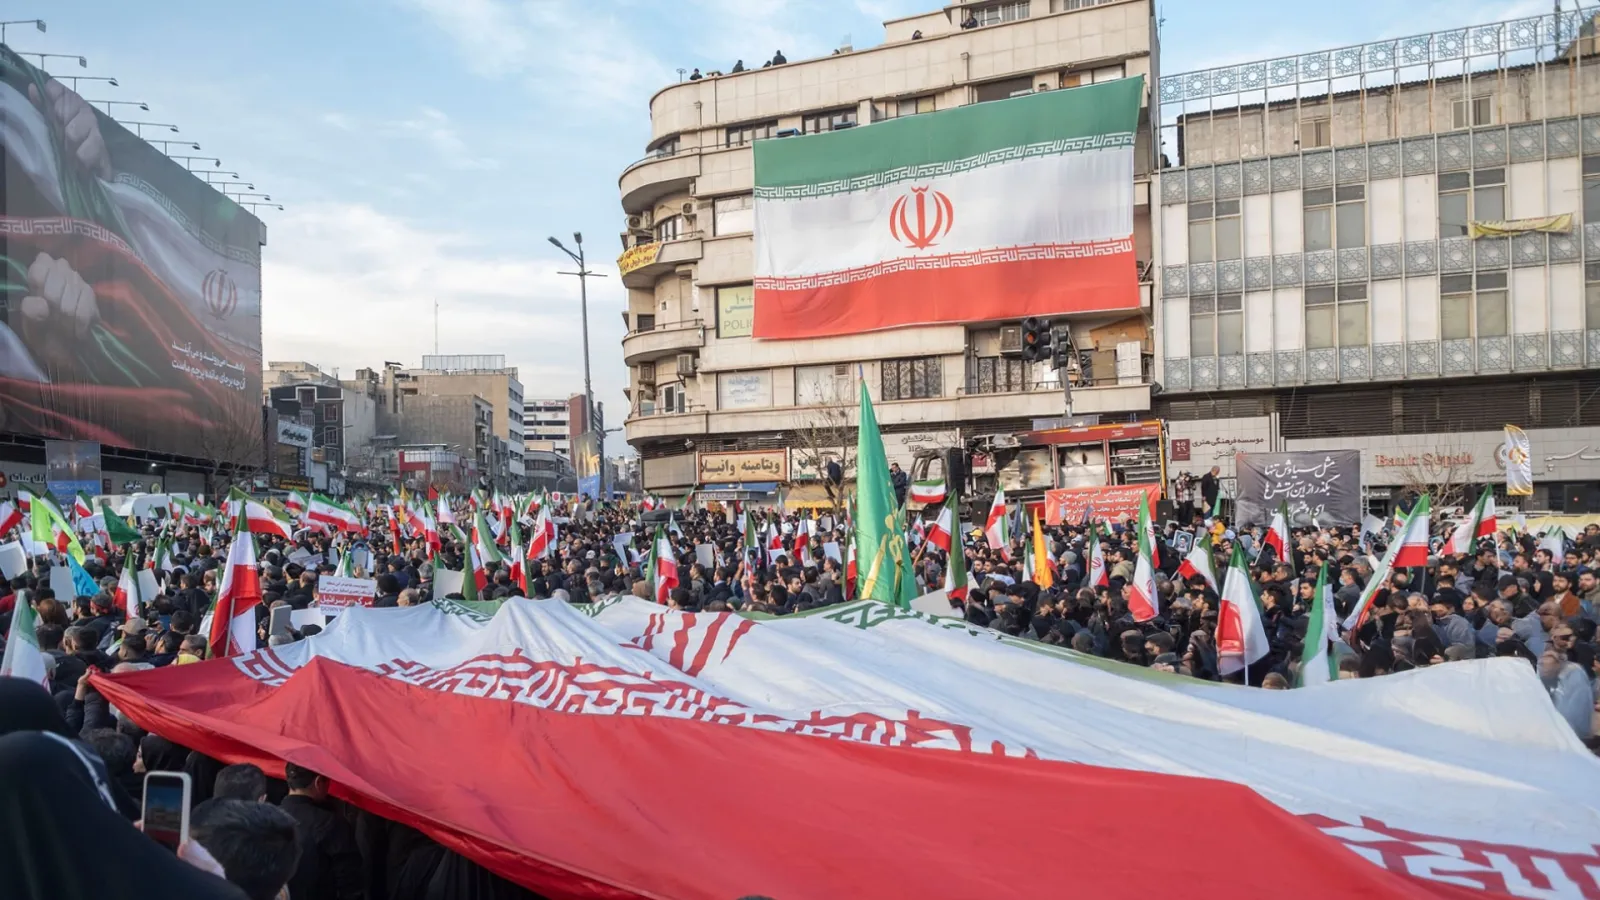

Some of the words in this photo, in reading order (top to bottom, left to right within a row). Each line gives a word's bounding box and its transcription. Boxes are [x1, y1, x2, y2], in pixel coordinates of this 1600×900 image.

[1192, 438, 1211, 447] هنری
[1211, 436, 1237, 447] فرهنگی
[741, 458, 780, 474] ویتامینه
[1314, 456, 1336, 478] مثل
[1375, 454, 1419, 467] Bank
[1422, 452, 1474, 468] Sepah
[1264, 463, 1280, 476] تنها
